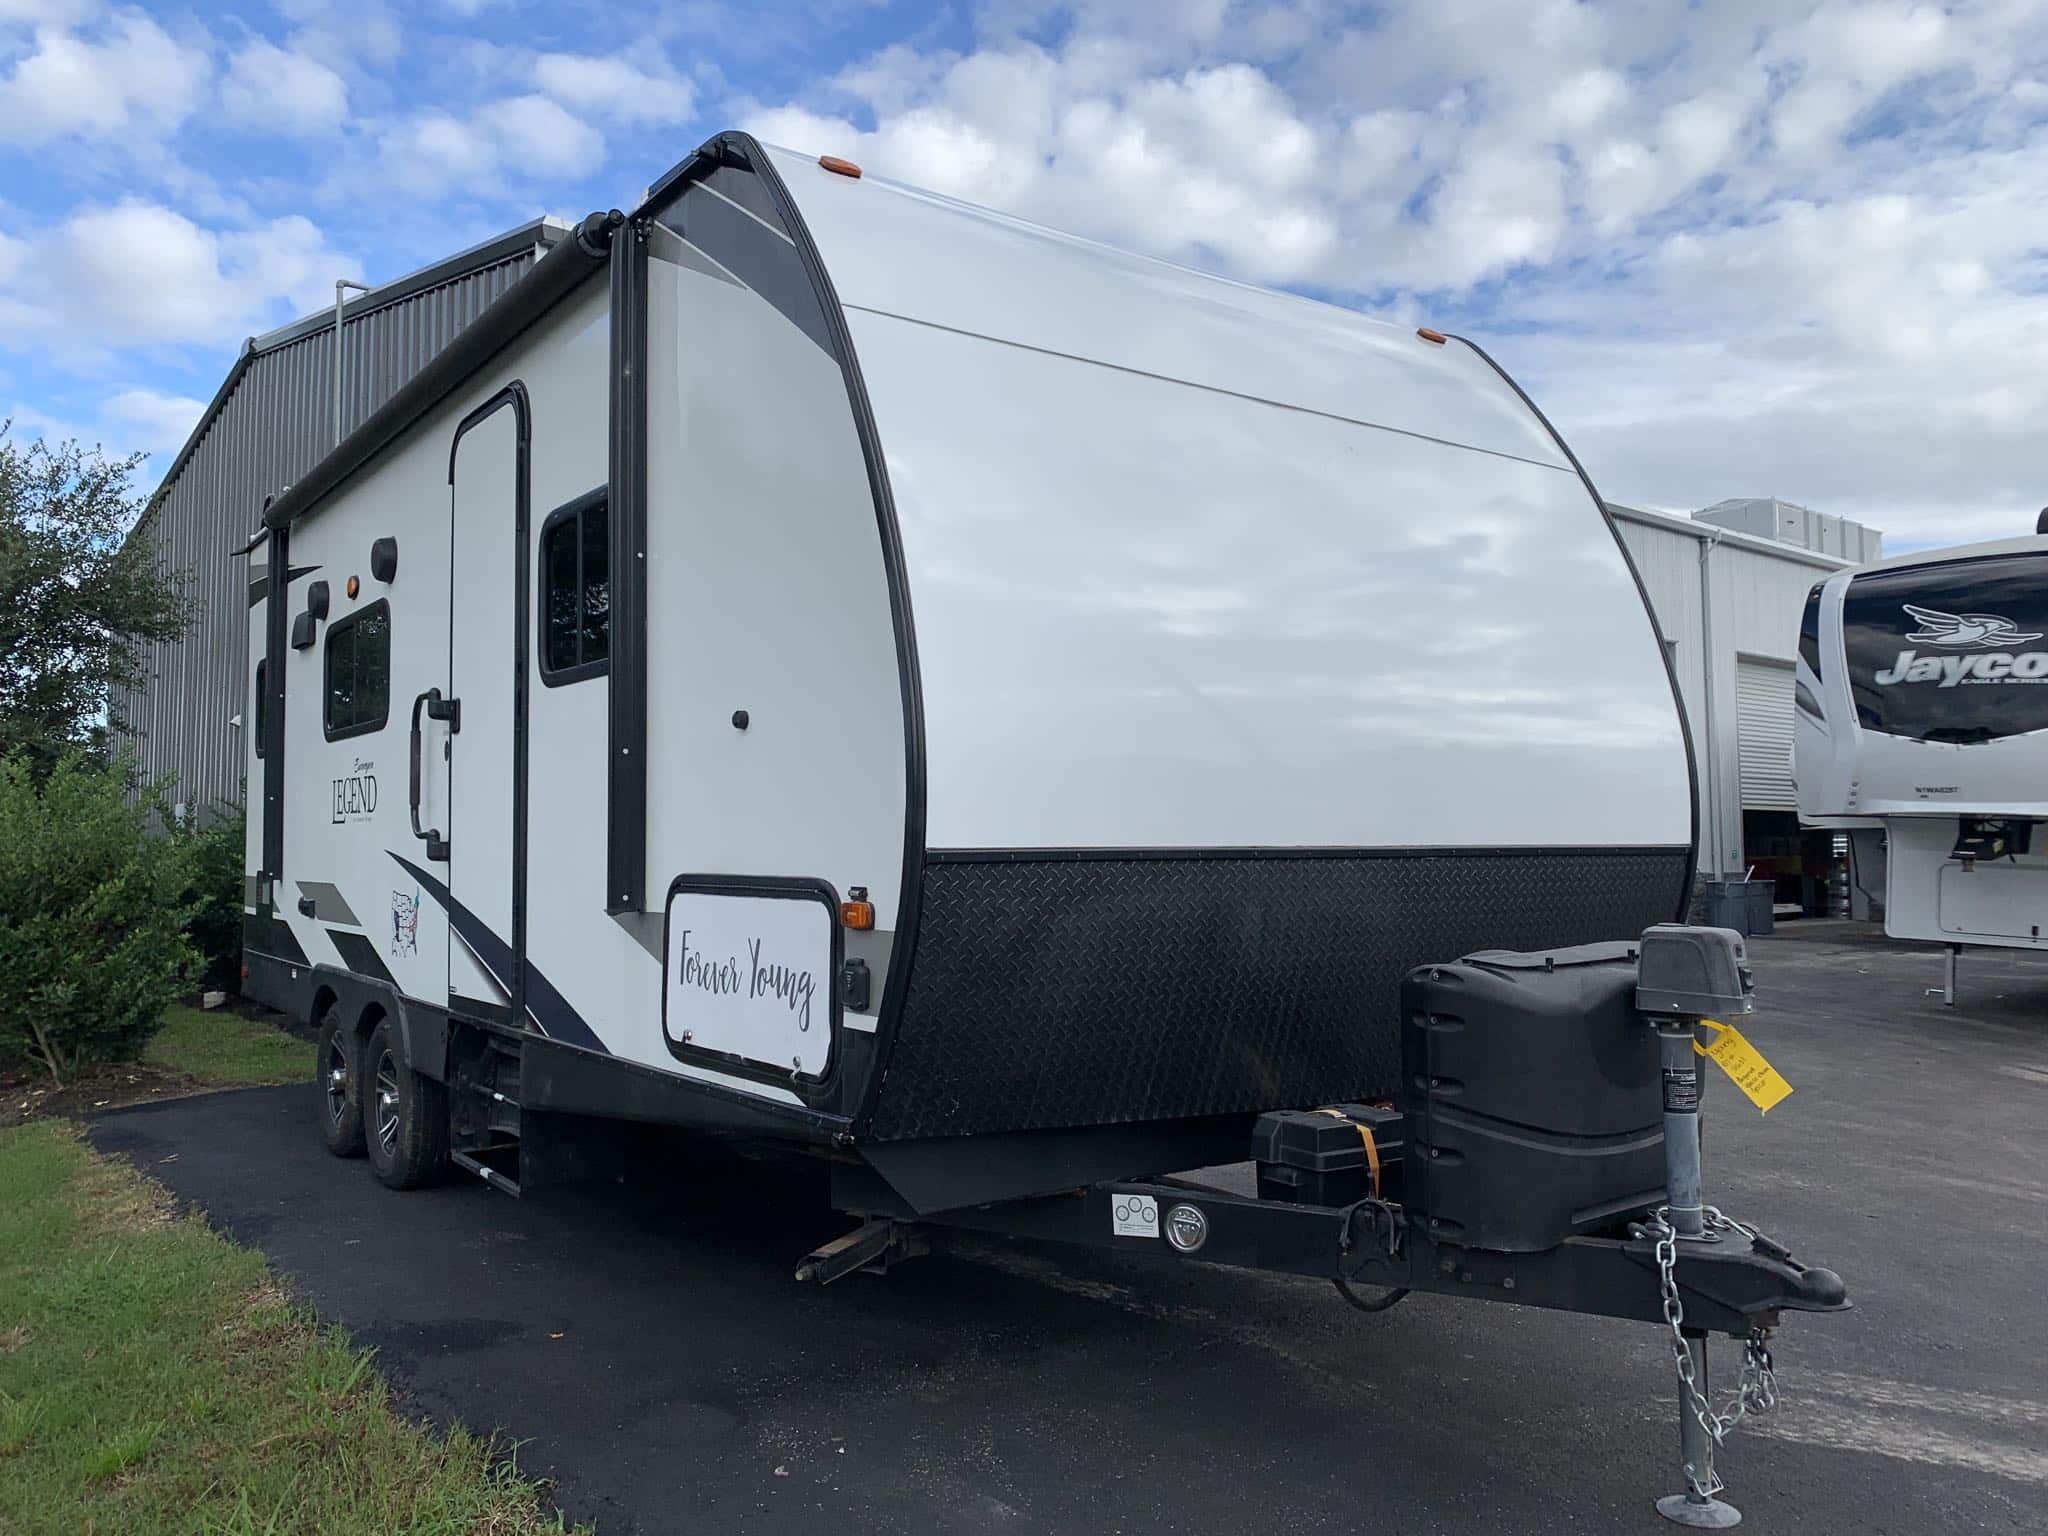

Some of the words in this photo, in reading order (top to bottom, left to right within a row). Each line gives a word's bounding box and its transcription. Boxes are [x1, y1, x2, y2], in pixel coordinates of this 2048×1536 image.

[1875, 650, 2048, 688] Jayco
[332, 775, 377, 825] LEGEND
[680, 930, 743, 995] Forever
[748, 937, 816, 1032] Young
